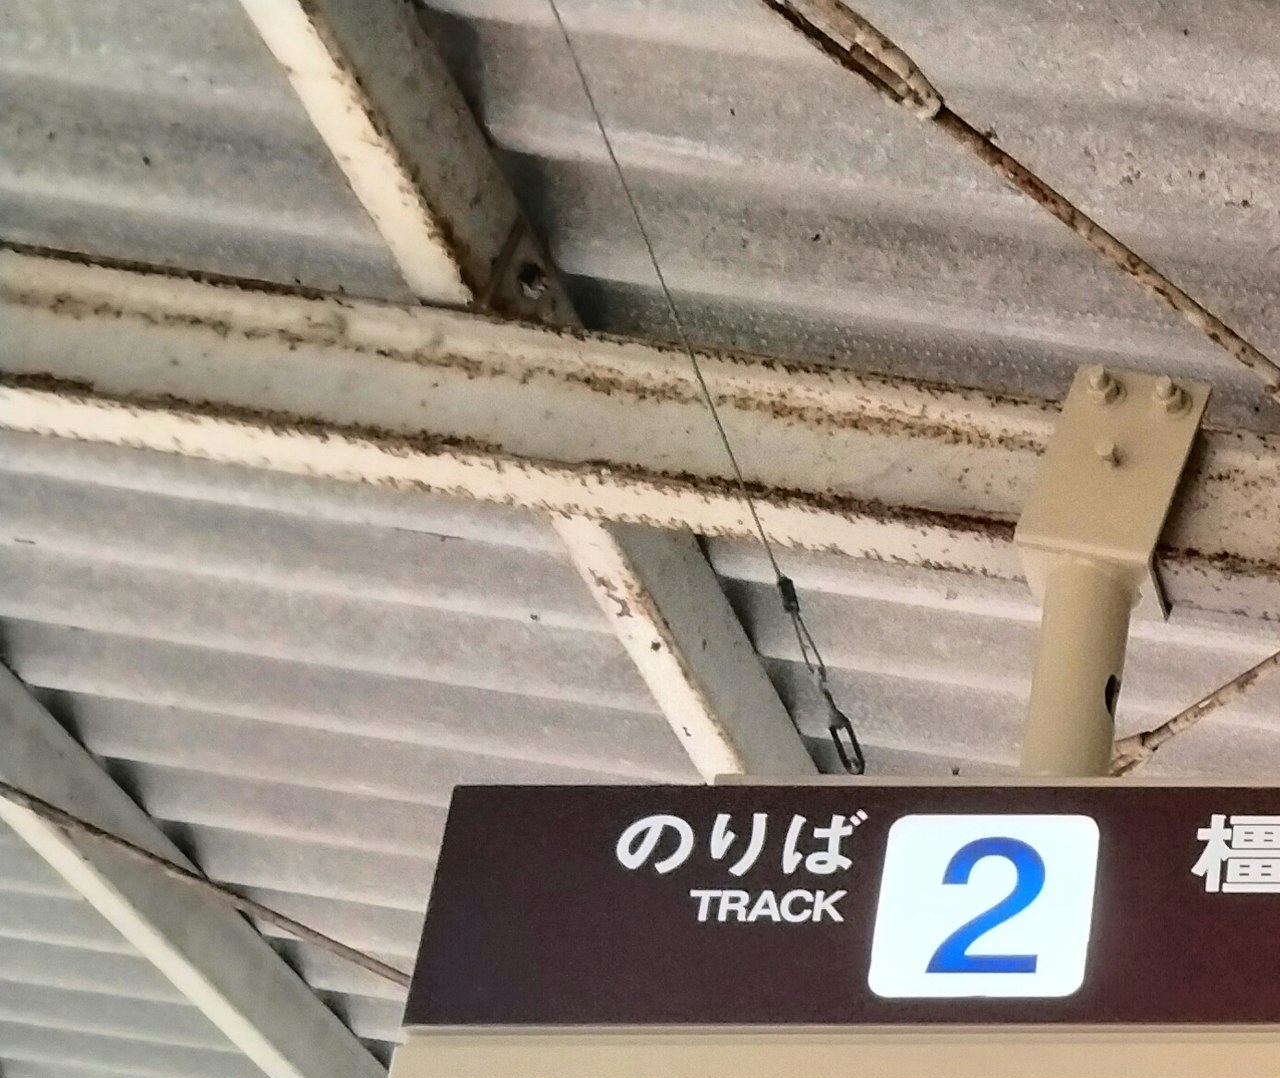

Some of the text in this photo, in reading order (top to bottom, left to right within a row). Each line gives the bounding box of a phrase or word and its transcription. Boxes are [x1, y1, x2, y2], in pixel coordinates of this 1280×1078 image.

[615, 808, 868, 877] のりば
[690, 889, 845, 923] TRACK
[924, 836, 1047, 974] 2
